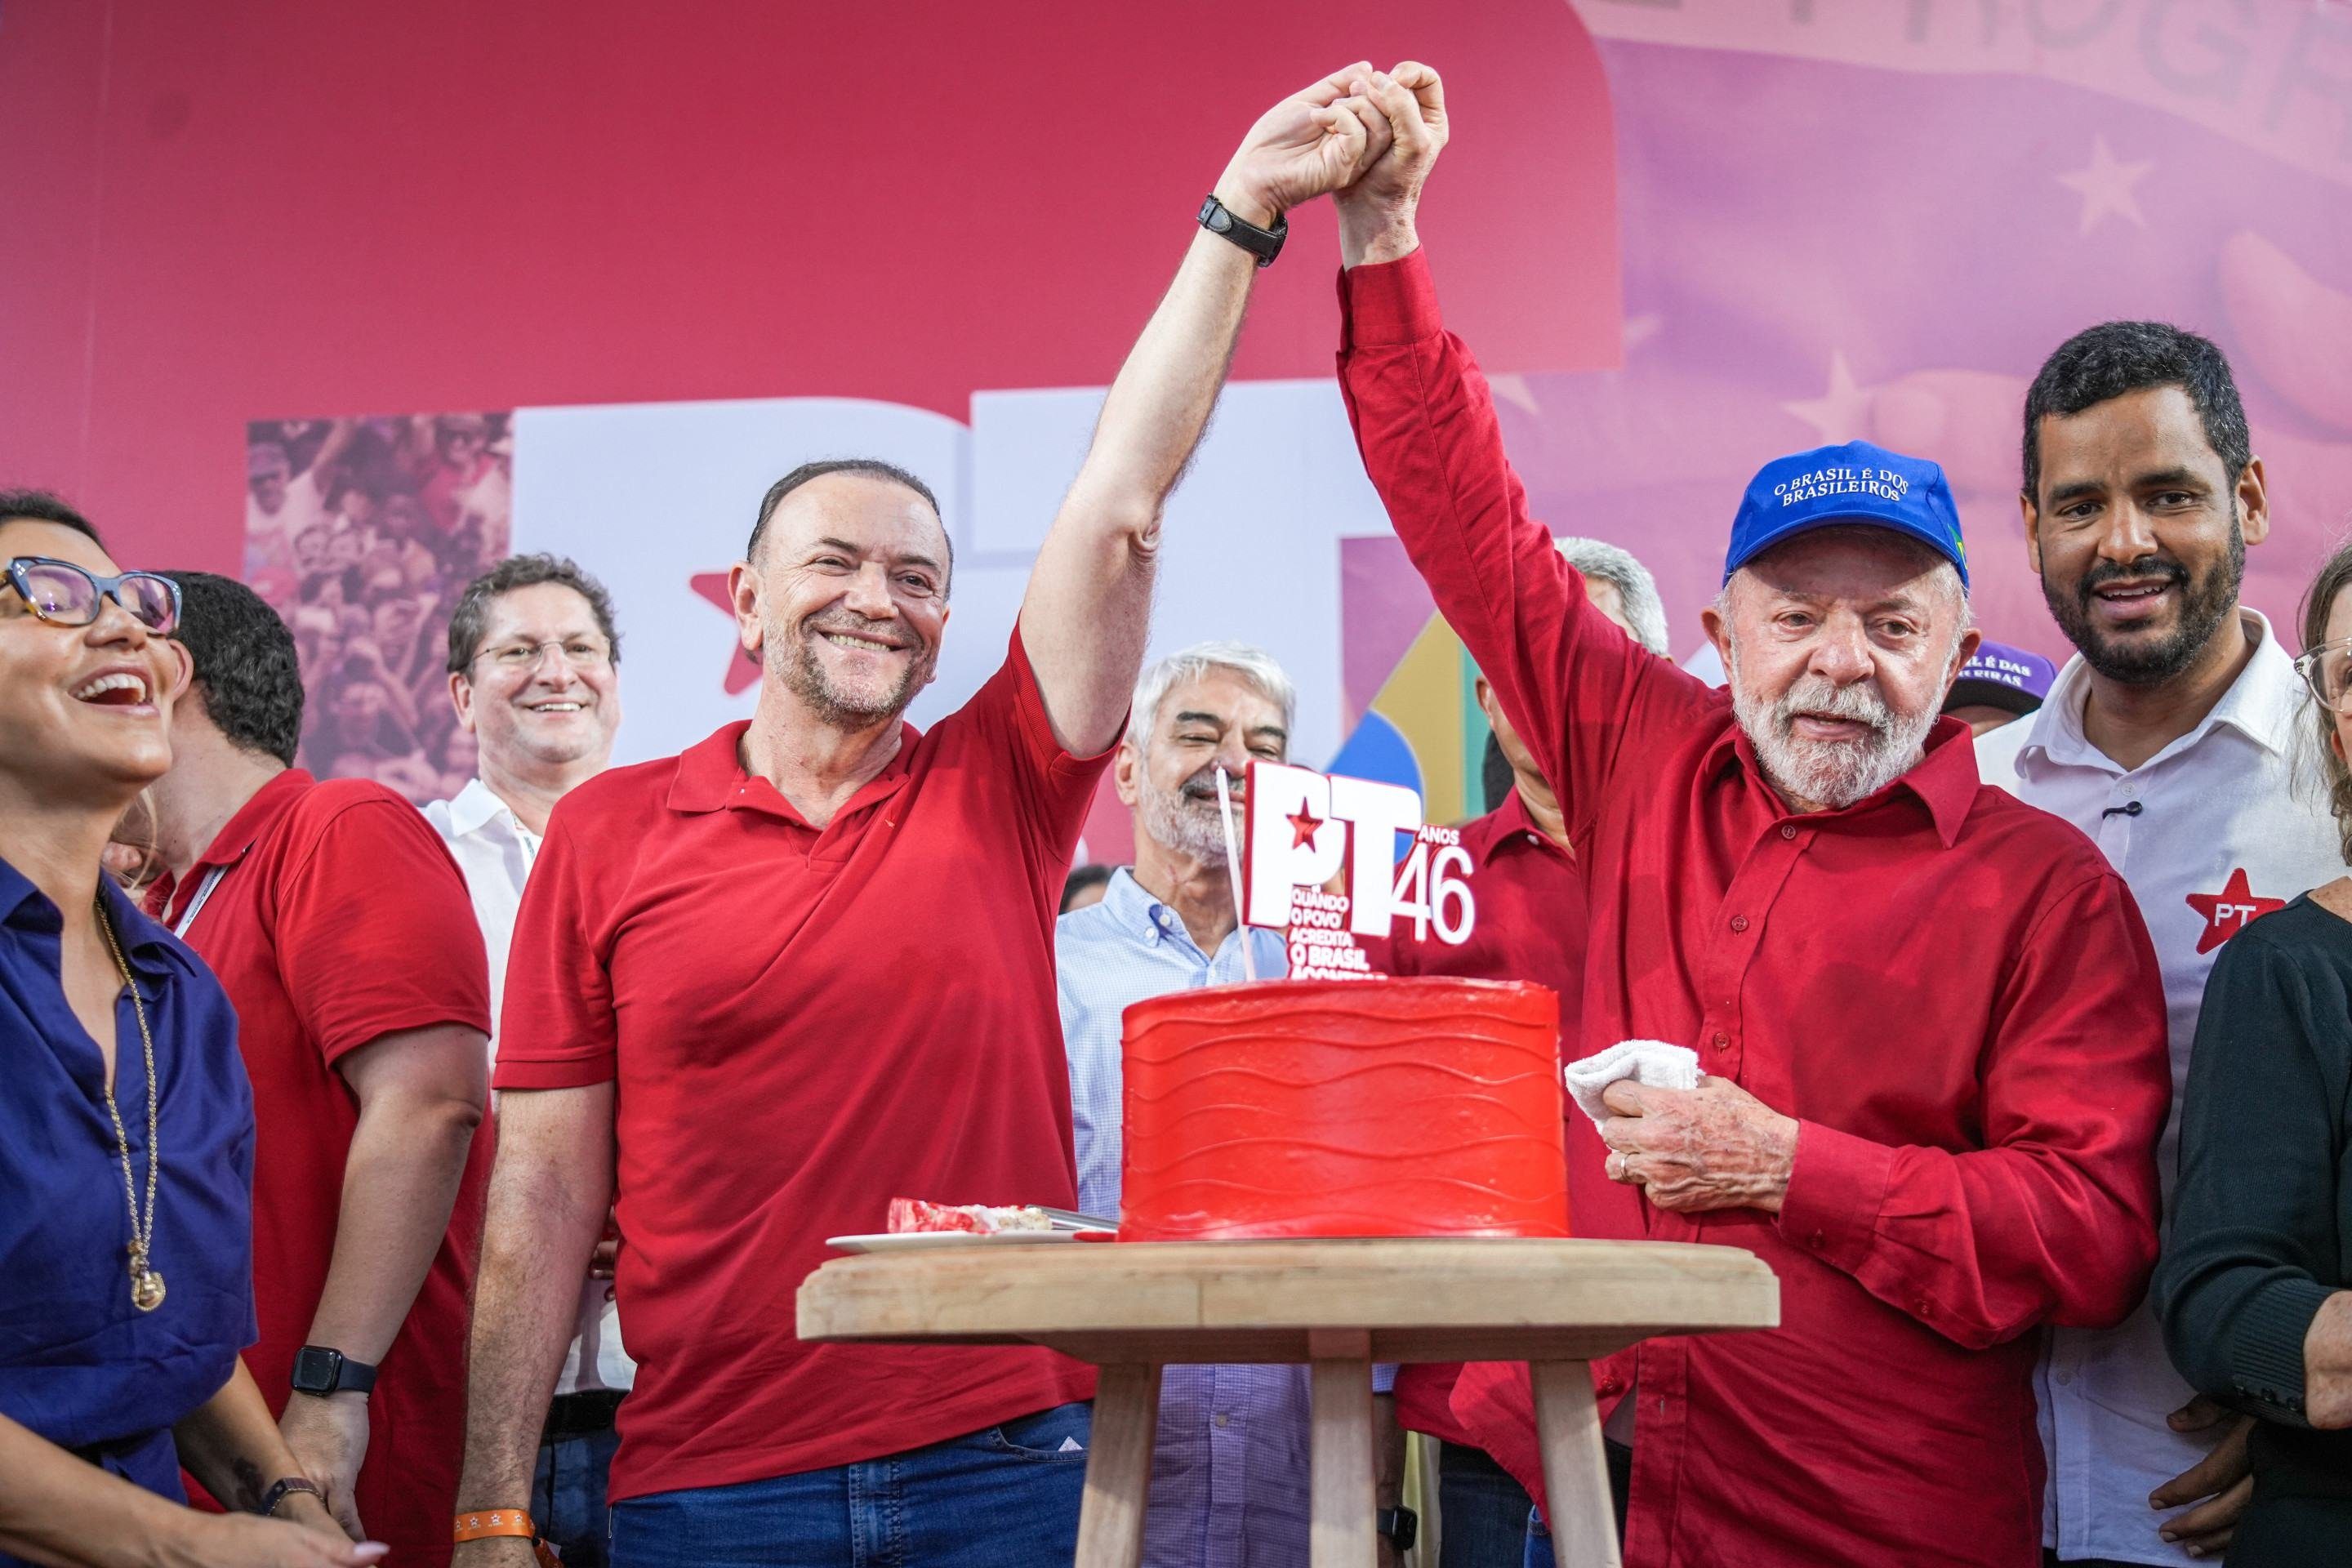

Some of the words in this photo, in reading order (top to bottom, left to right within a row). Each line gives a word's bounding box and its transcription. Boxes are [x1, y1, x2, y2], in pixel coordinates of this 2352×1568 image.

[1774, 483, 1786, 497] O
[1790, 468, 1856, 491] BRASIL
[1861, 467, 1873, 479] É
[1879, 470, 1909, 496] DOS
[1782, 480, 1900, 507] BRASILEIROS
[1984, 654, 1996, 669] É
[1998, 659, 2031, 678] DAS
[1418, 825, 1459, 845] ANOS
[1245, 760, 1422, 938] PT
[1291, 887, 1350, 914] QUANDO
[1390, 842, 1475, 945] 46
[1290, 906, 1303, 926] O
[1303, 907, 1342, 929] POVO
[2214, 903, 2256, 928] PT
[1289, 927, 1355, 948] ACREDITA
[1290, 943, 1307, 966] O
[1307, 945, 1370, 972] BRASIL
